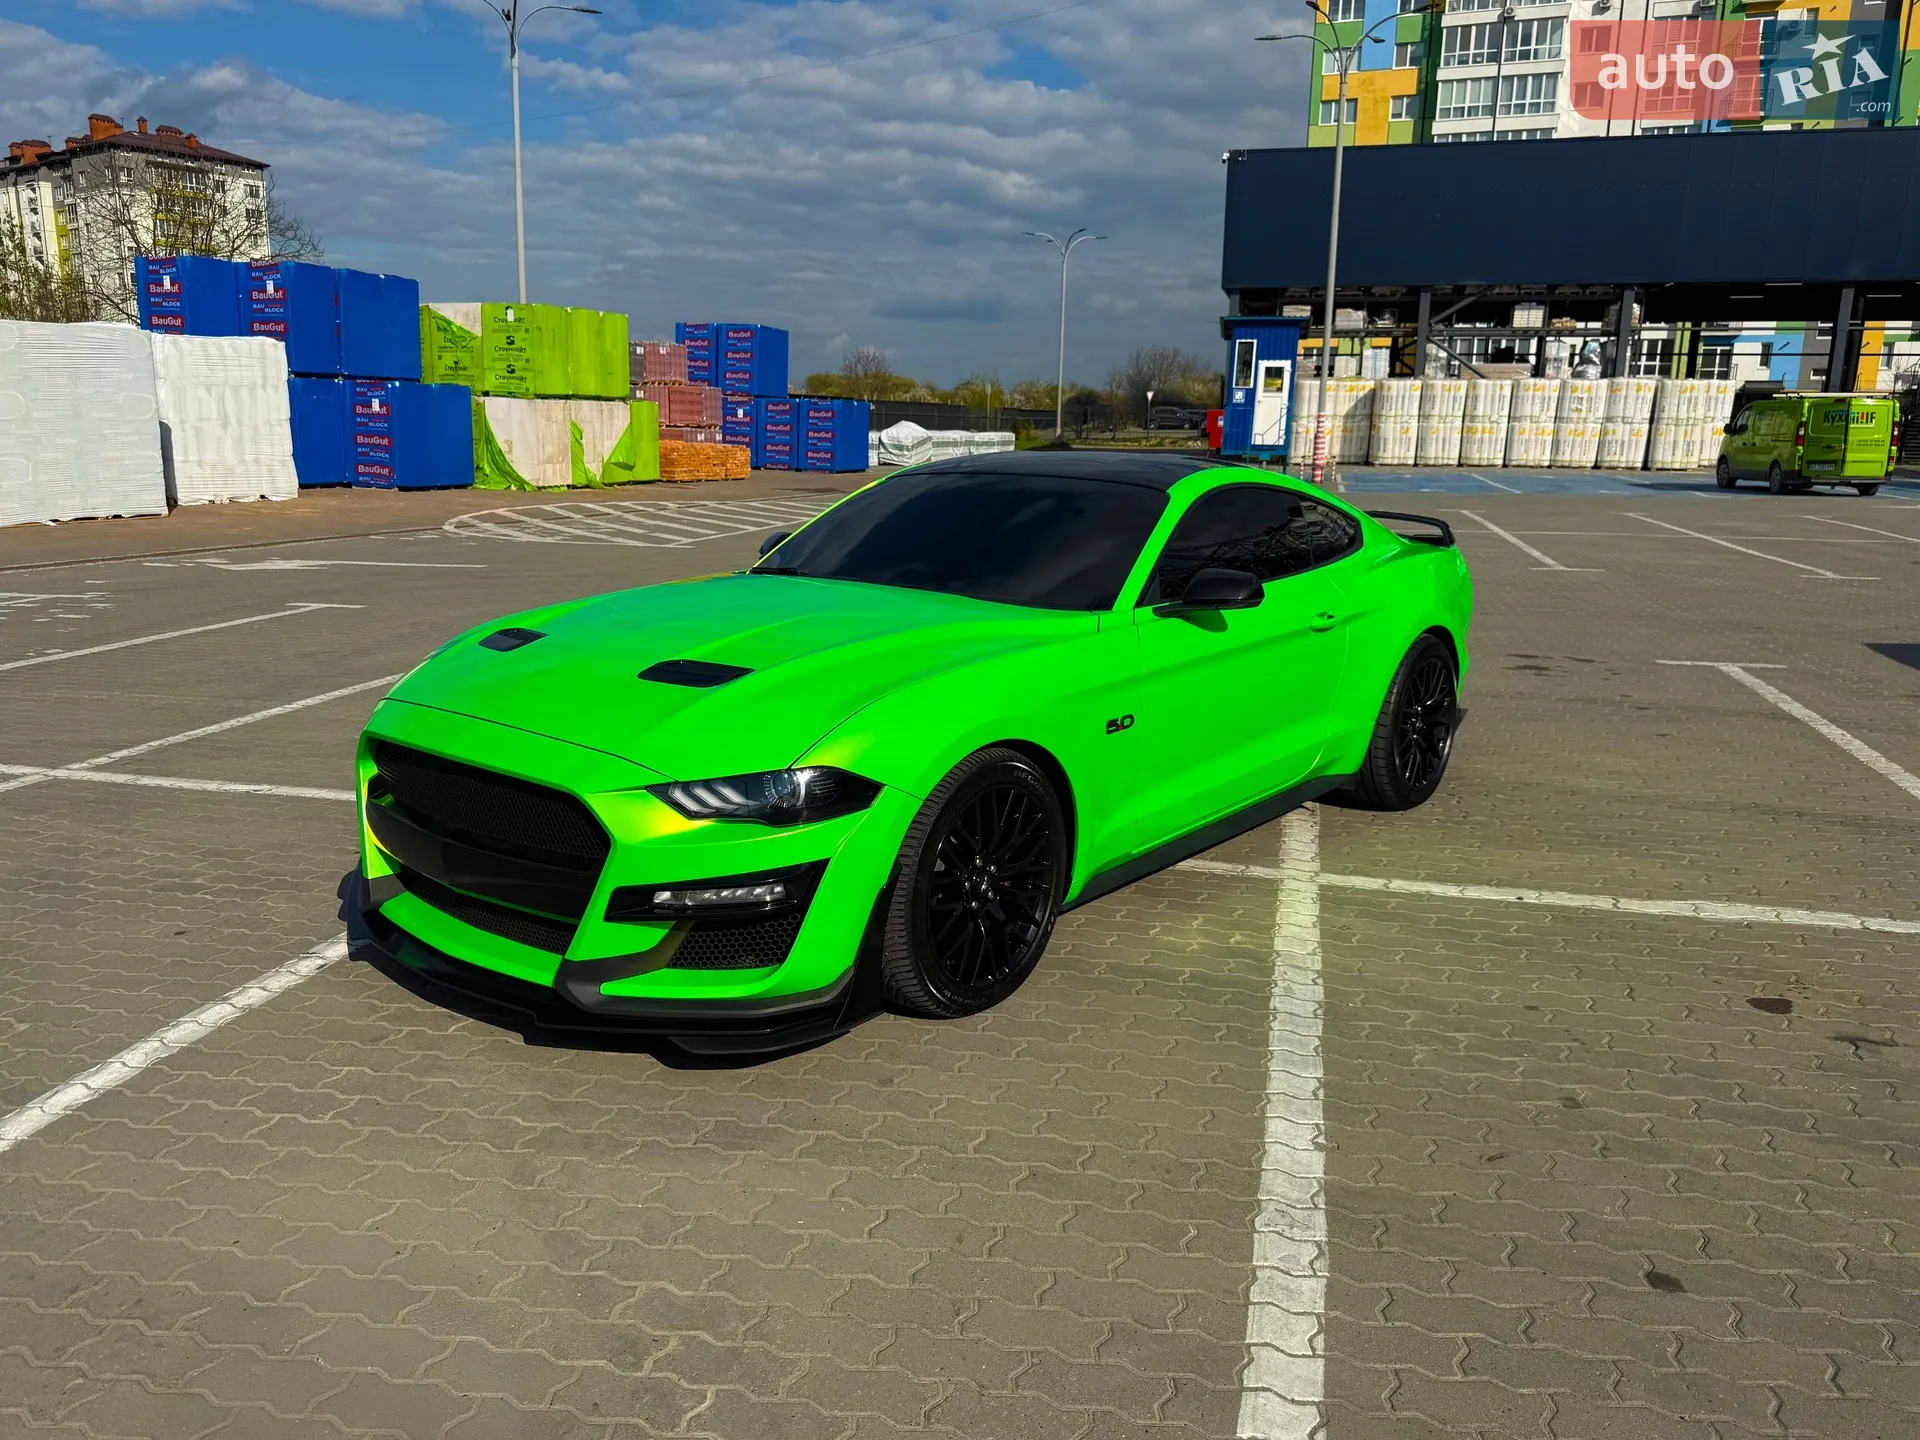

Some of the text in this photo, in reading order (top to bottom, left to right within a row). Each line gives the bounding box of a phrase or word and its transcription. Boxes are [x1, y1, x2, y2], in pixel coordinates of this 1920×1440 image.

[151, 316, 183, 327] BauGut
[253, 322, 285, 332] BauGut
[356, 435, 390, 446] BauGut
[766, 444, 790, 452] BauGut
[807, 451, 832, 459] BauGut
[358, 464, 392, 476] BauGut
[1105, 713, 1135, 736] 5.0
